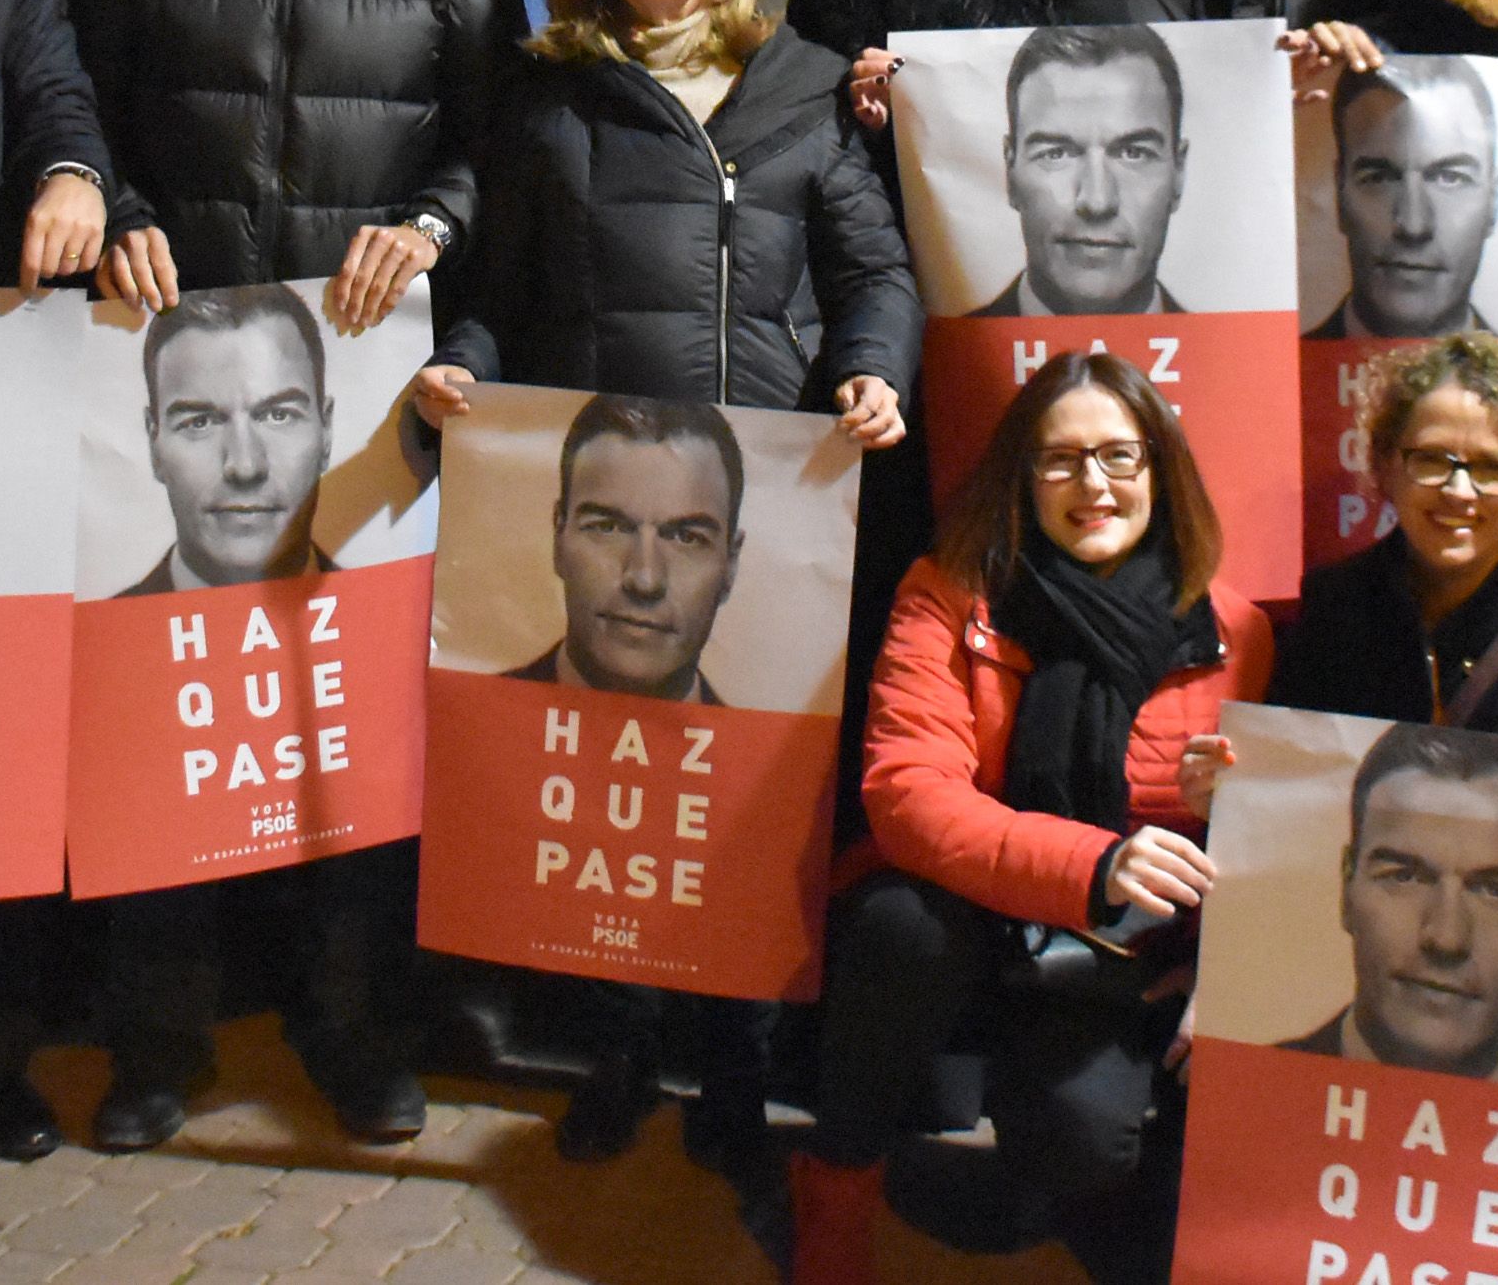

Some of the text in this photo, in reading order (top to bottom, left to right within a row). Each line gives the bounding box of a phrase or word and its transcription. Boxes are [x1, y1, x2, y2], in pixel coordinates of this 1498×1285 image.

[169, 595, 339, 662] HAZ
[177, 660, 344, 728] QUE
[182, 725, 349, 796] PASE
[544, 707, 715, 775] HAZ
[251, 800, 296, 817] VOTA
[251, 813, 297, 838] PSOE
[540, 775, 709, 841] QUE
[534, 840, 705, 907] PASE
[593, 925, 639, 950] PSOE
[594, 913, 640, 929] VOTA
